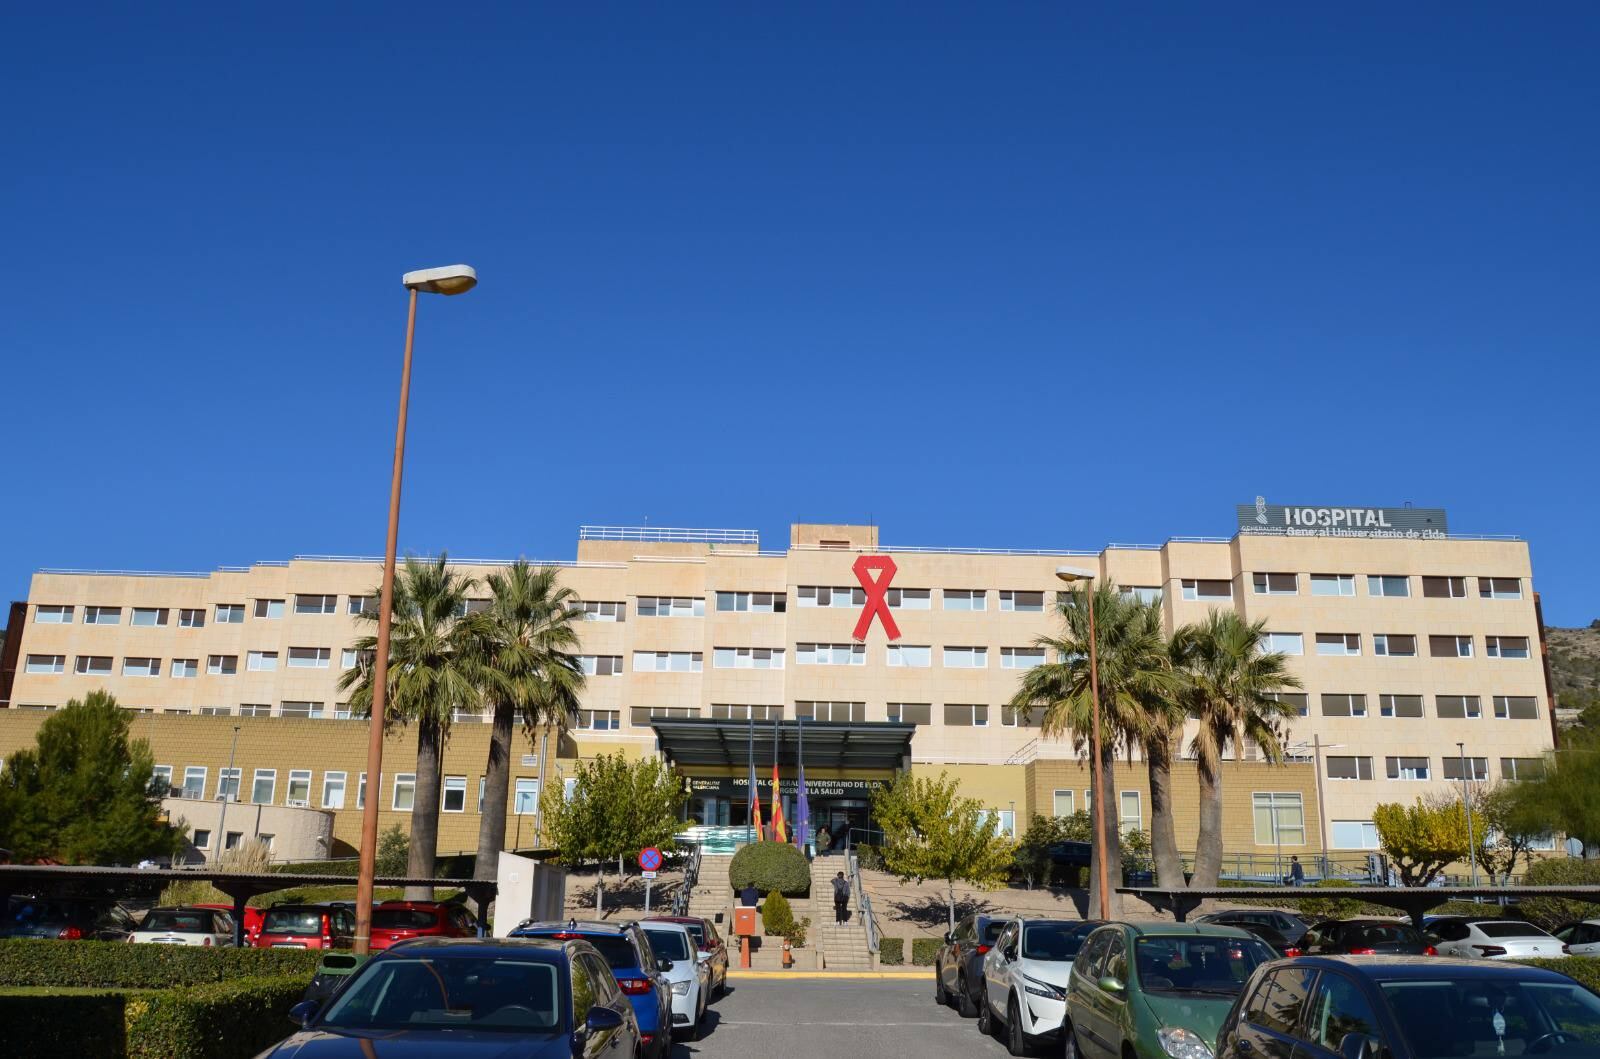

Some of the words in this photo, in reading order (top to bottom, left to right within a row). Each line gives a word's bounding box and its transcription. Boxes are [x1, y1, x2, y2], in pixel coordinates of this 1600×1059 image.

[1284, 508, 1392, 527] HOSPITAL
[1286, 527, 1329, 537] General
[1332, 528, 1402, 538] Universitario
[1405, 529, 1420, 538] de
[1422, 529, 1446, 539] Elda
